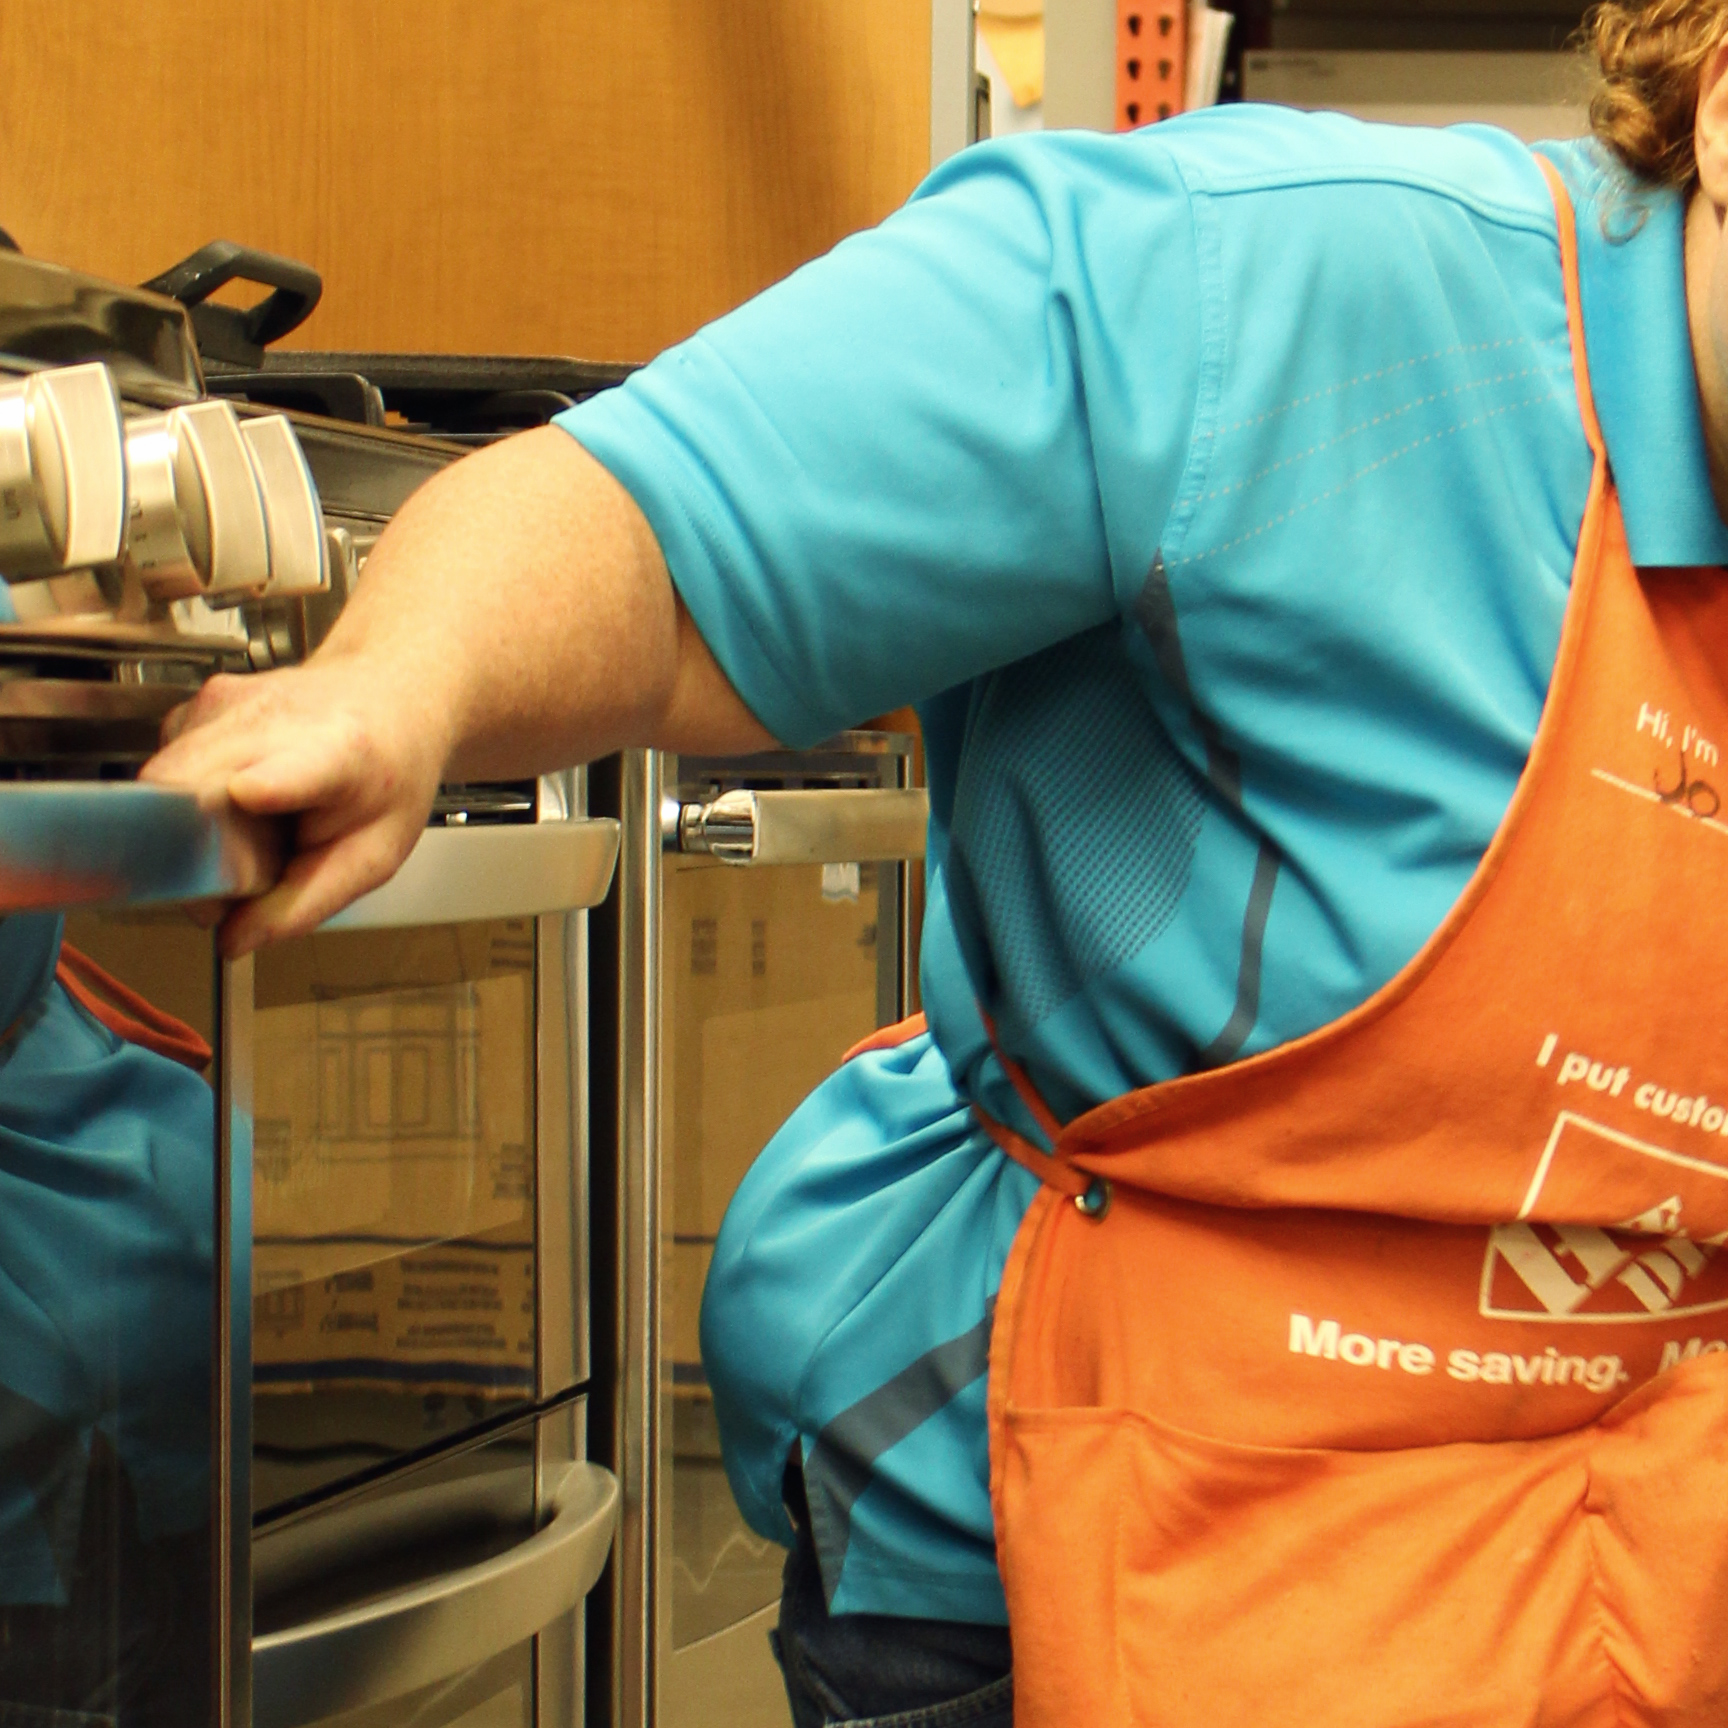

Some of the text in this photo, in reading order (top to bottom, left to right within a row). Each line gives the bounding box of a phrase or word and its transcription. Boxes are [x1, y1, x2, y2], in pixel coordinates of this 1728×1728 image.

[1635, 701, 1719, 767] Hi, I'm
[1536, 1033, 1559, 1068] I
[1556, 1052, 1631, 1098] put
[1288, 1313, 1436, 1373] More
[1447, 1343, 1629, 1394] saving.
